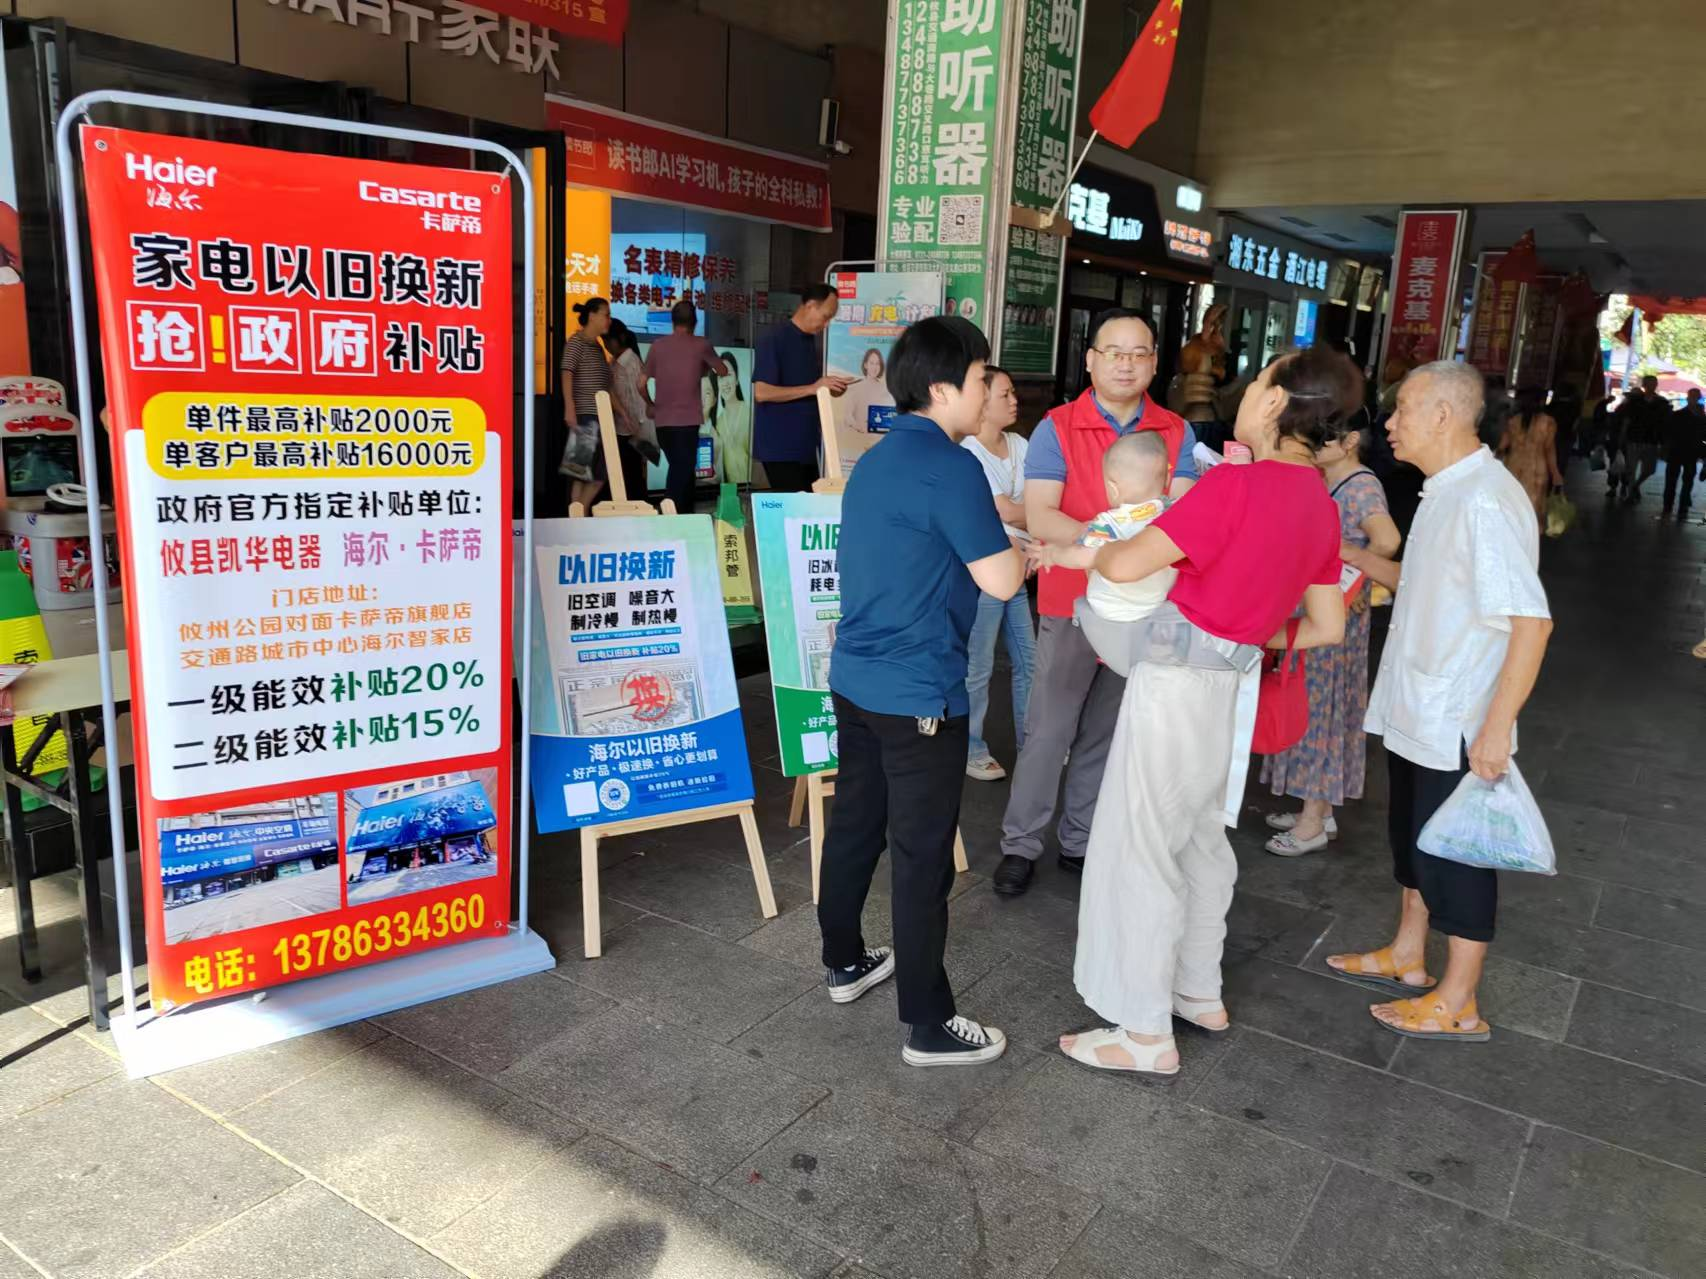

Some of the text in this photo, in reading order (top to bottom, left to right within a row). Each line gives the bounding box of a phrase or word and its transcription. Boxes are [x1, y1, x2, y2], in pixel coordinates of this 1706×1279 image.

[894, 3, 913, 185] 13487737366
[907, 1, 928, 185] 24888738
[125, 152, 217, 188] Haier
[358, 180, 482, 214] Casarte
[892, 195, 935, 218] 专业
[419, 212, 482, 235] 卡萨帝
[891, 220, 935, 244] 验配
[130, 231, 485, 310] 家电以旧换新
[565, 252, 601, 278] 天才
[623, 244, 737, 283] 名表精修保养
[610, 280, 677, 307] 换各类电子
[135, 308, 485, 374] 抢！政府补贴
[186, 404, 453, 434] 单件最高补贴2000元
[164, 441, 473, 470] 单客户最高补贴16000元
[157, 489, 483, 525] 政府官方指定补贴单位：
[761, 500, 783, 510] Haier
[160, 533, 322, 578] 攸县凯华电器
[558, 549, 676, 585] 以旧换新
[808, 559, 838, 574] 旧冰
[271, 586, 379, 608] 门店地址：
[568, 588, 675, 611] 旧空调 噪音大
[810, 577, 840, 592] 耗电
[178, 601, 473, 643] 攸州公园对面卡萨帝旗舰店
[570, 607, 678, 631] 制冷慢 制热慢
[179, 626, 473, 670] 交通路城市中心海尔智家店
[167, 659, 484, 716] 一级能效补贴20%
[171, 704, 481, 770] 二级能效补贴15%
[588, 731, 698, 763] 海尔以旧换新
[175, 831, 224, 847] Haier
[352, 813, 405, 837] Haier
[162, 863, 198, 877] Haier
[184, 893, 486, 995] 电话： 13786334360
